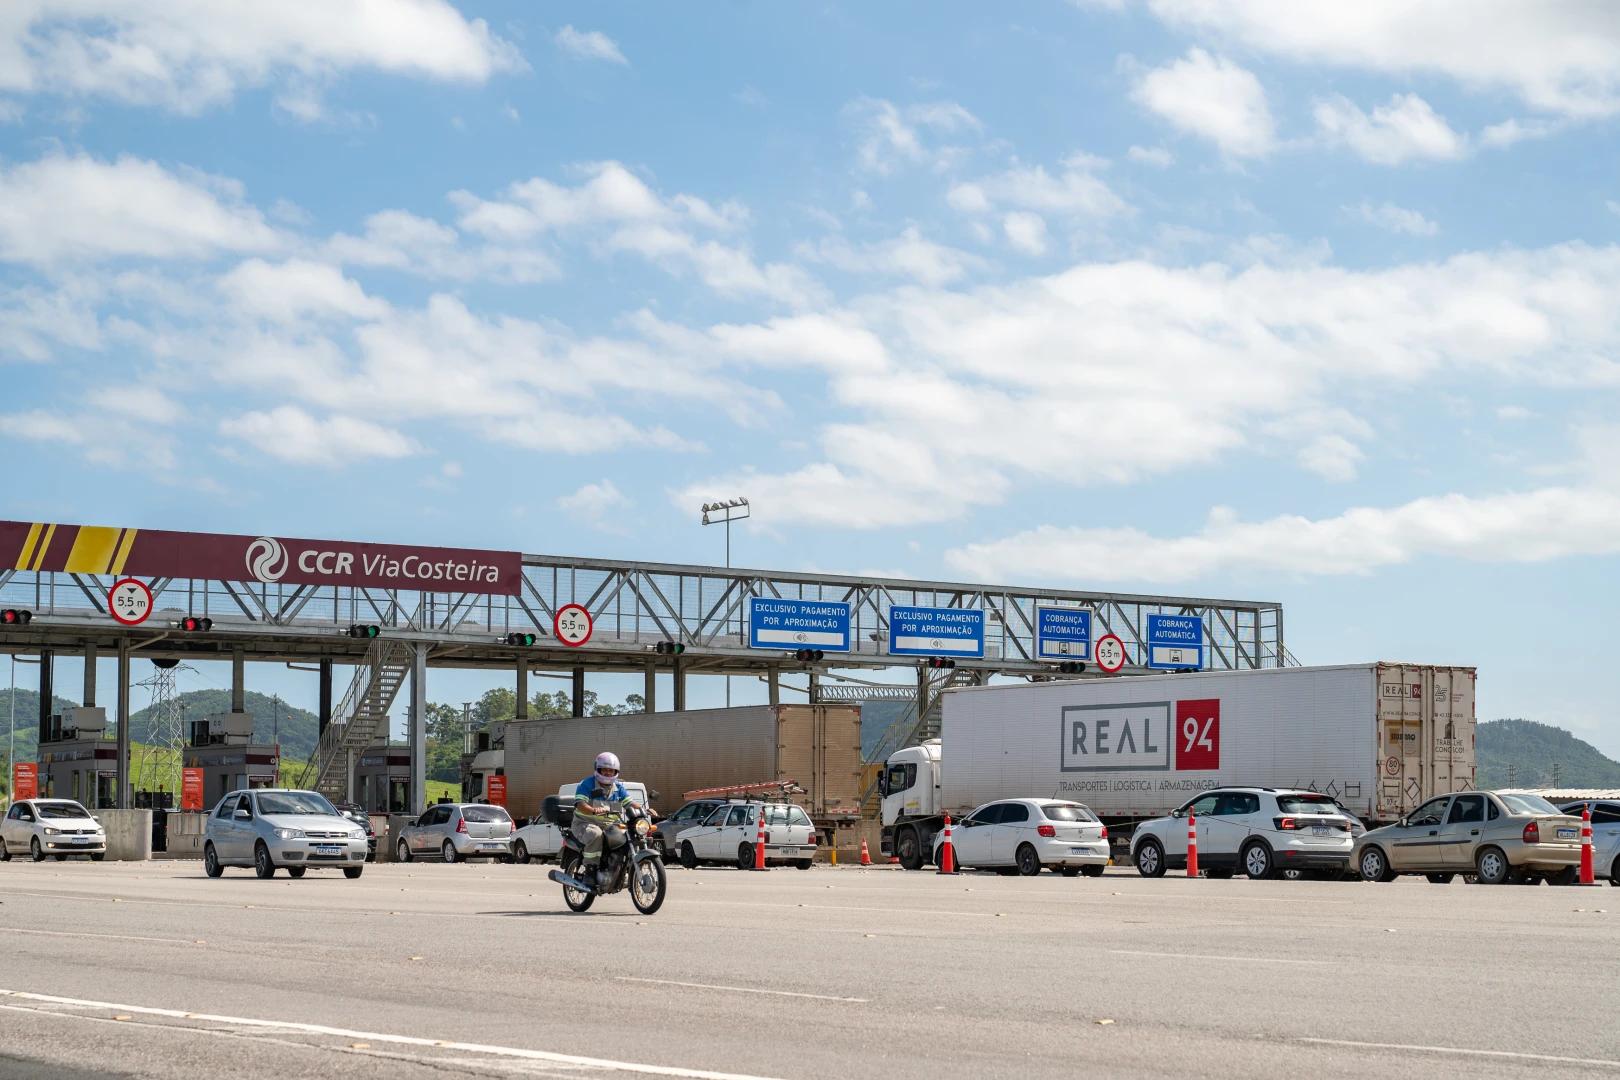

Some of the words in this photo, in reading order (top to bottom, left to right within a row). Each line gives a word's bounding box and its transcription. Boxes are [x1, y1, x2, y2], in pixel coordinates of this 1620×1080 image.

[298, 550, 354, 575] CCR
[362, 553, 499, 583] ViaCosteira
[755, 603, 797, 614] EXCLUSIVO
[801, 606, 846, 617] PAGAMENTO
[763, 616, 779, 625] POR
[784, 617, 838, 629] APROXIMAÇÃO
[894, 611, 933, 621] EXCLUSIVO
[936, 613, 980, 623] PAGAMENTO
[1045, 614, 1083, 625] COBRANÇA
[578, 623, 586, 631] m
[902, 623, 917, 632] POR
[921, 625, 972, 635] APROXIMAÇÃO
[1157, 619, 1194, 629] COBRANÇA
[1385, 685, 1409, 695] REAL
[1072, 718, 1158, 755] REAL
[1183, 717, 1214, 752] 94
[1436, 739, 1464, 747] TRABLHE
[1059, 780, 1108, 792] TRANSPORTES
[1113, 779, 1152, 792] LOGÍSTICA
[1159, 779, 1220, 791] ARMAZENAGEM
